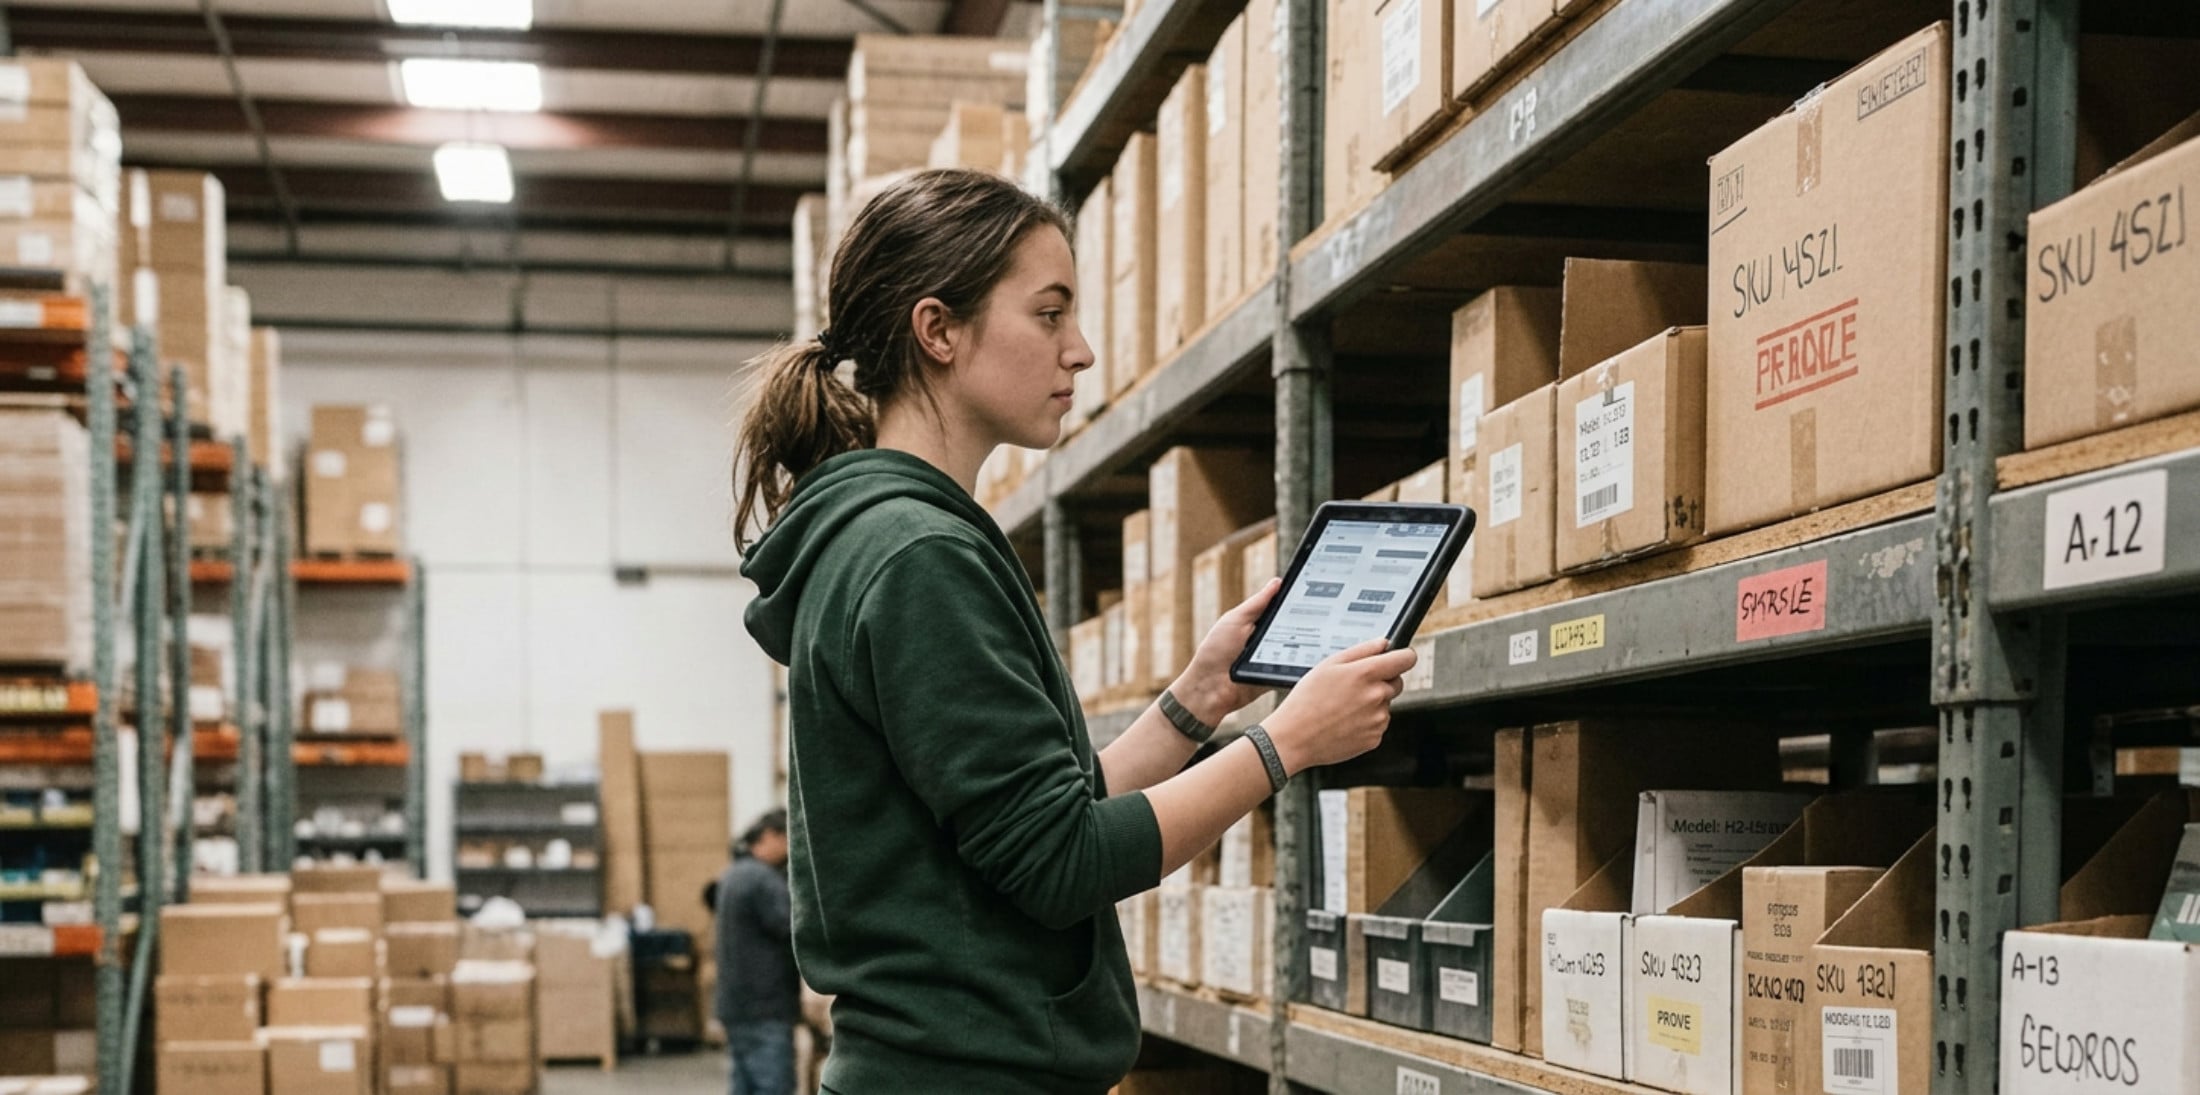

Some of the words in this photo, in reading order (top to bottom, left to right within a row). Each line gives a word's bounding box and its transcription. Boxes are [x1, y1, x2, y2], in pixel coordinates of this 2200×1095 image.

[2038, 226, 2096, 303] SKU
[1733, 254, 1773, 319] SKU
[1816, 963, 1846, 994] SKU
[2011, 951, 2059, 986] A-13
[1656, 1010, 1691, 1030] PROVE
